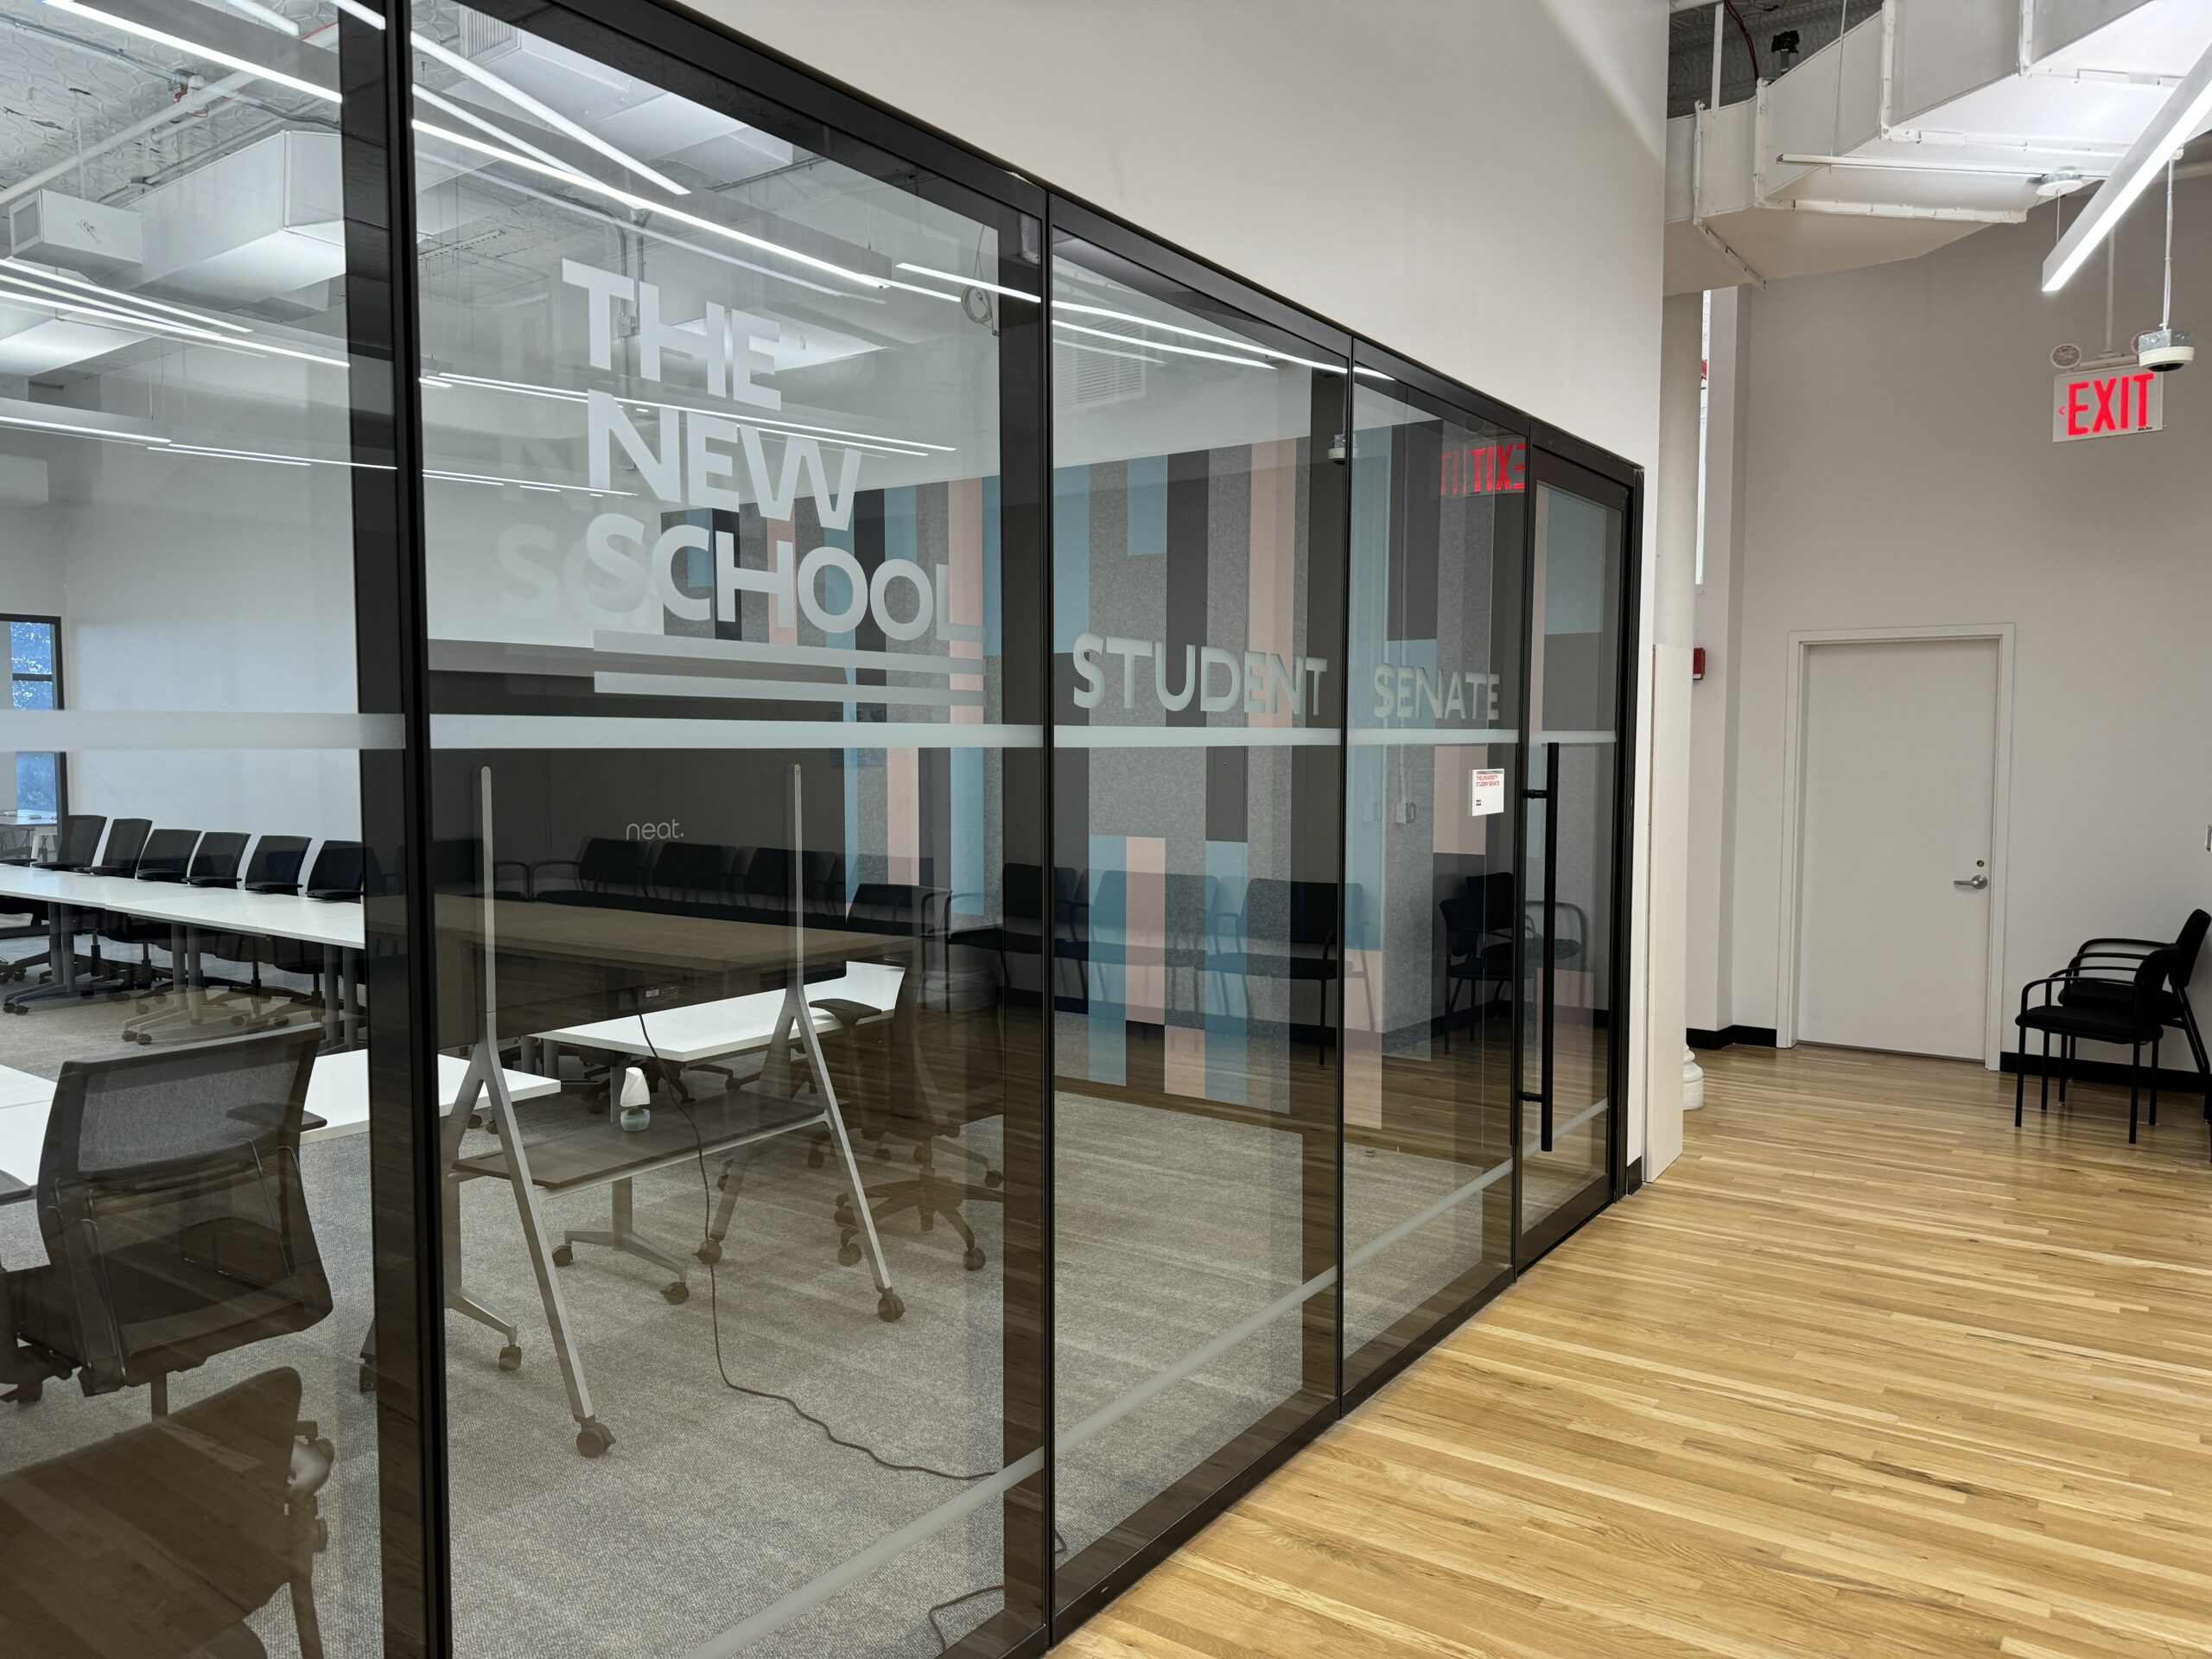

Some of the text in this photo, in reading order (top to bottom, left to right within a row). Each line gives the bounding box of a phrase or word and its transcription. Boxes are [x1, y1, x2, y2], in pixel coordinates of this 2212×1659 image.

[563, 257, 781, 411] THE
[2067, 372, 2155, 436] EXIT
[588, 388, 862, 531] NEW
[586, 512, 985, 644] SCHOOL
[1072, 632, 1500, 721] STUDENT SENATE
[626, 817, 685, 841] neat.
